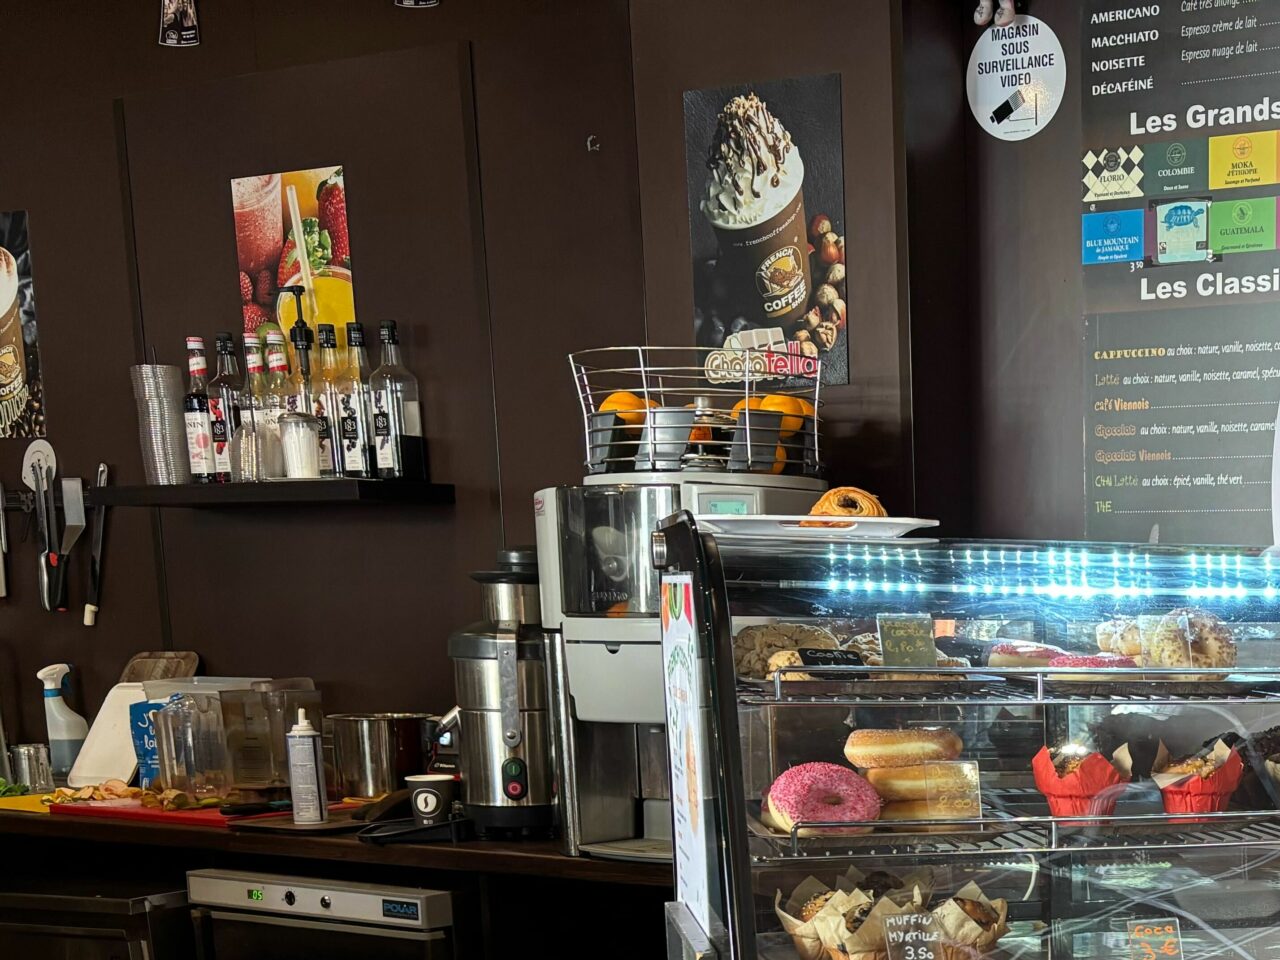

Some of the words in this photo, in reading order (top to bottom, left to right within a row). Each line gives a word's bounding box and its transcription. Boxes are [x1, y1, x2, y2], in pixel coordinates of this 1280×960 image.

[1090, 4, 1160, 24] AMERICANO
[991, 23, 1039, 42] MAGASIN
[1181, 21, 1210, 38] Espresso
[1211, 19, 1233, 34] crème
[1001, 40, 1029, 56] SOUS
[1091, 29, 1159, 49] MACCHIATO
[1181, 46, 1210, 62] Espresso
[1211, 44, 1234, 58] nuage
[977, 53, 1054, 75] SURVEILLANCE
[1091, 55, 1146, 73] NOISETTE
[1000, 72, 1031, 88] VIDEO
[1092, 76, 1154, 96] DÉCAFÉINÉ
[1130, 112, 1177, 136] Les
[1157, 166, 1195, 178] COLOMBIE
[1231, 160, 1253, 171] MOKA
[1219, 225, 1265, 236] GUATEMALA
[1086, 237, 1102, 248] BLUE
[1103, 236, 1139, 247] MOUNTAIN
[761, 247, 794, 271] FRENCH
[764, 279, 806, 312] COFFEE
[1140, 277, 1188, 300] Les
[1094, 347, 1167, 360] CAPPUCCINO
[1114, 397, 1150, 412] Viennois
[384, 903, 417, 914] POLAR
